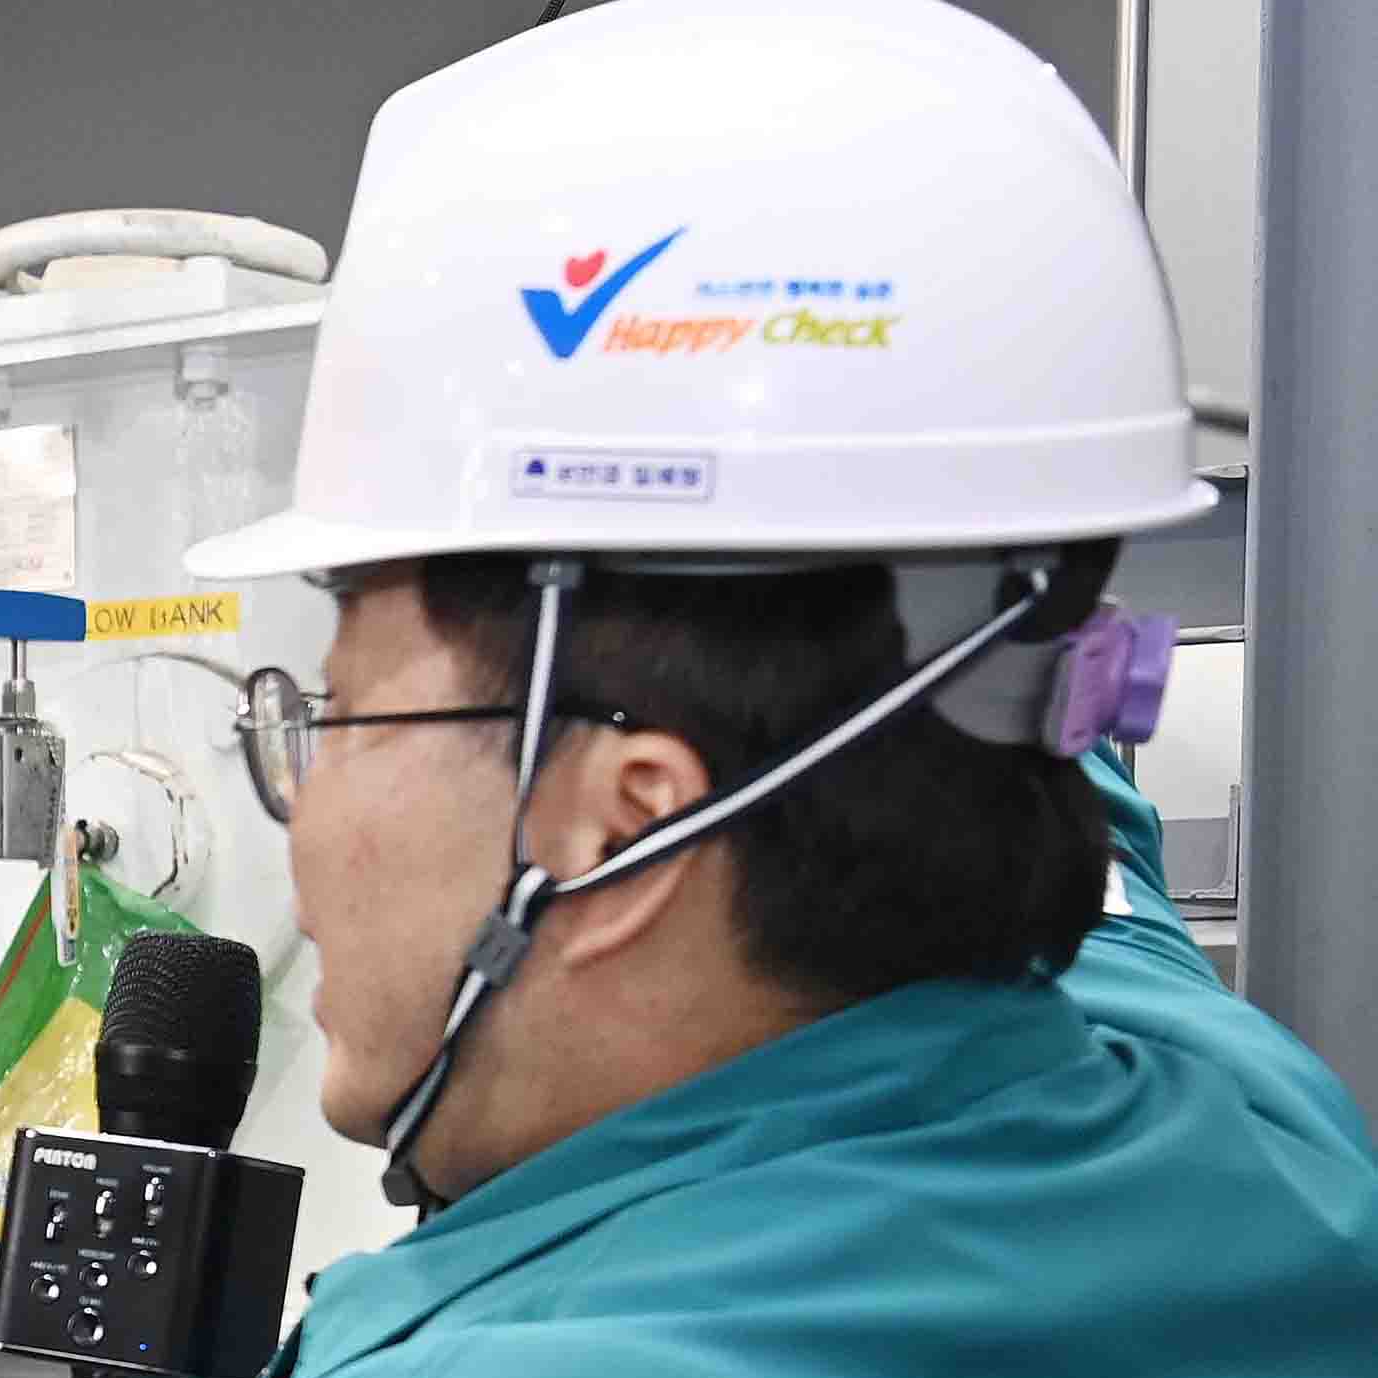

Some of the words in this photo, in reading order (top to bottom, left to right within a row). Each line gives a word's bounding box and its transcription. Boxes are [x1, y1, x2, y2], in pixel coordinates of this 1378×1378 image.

[605, 312, 755, 355] Happy
[764, 308, 905, 347] Check
[91, 607, 135, 633] OW
